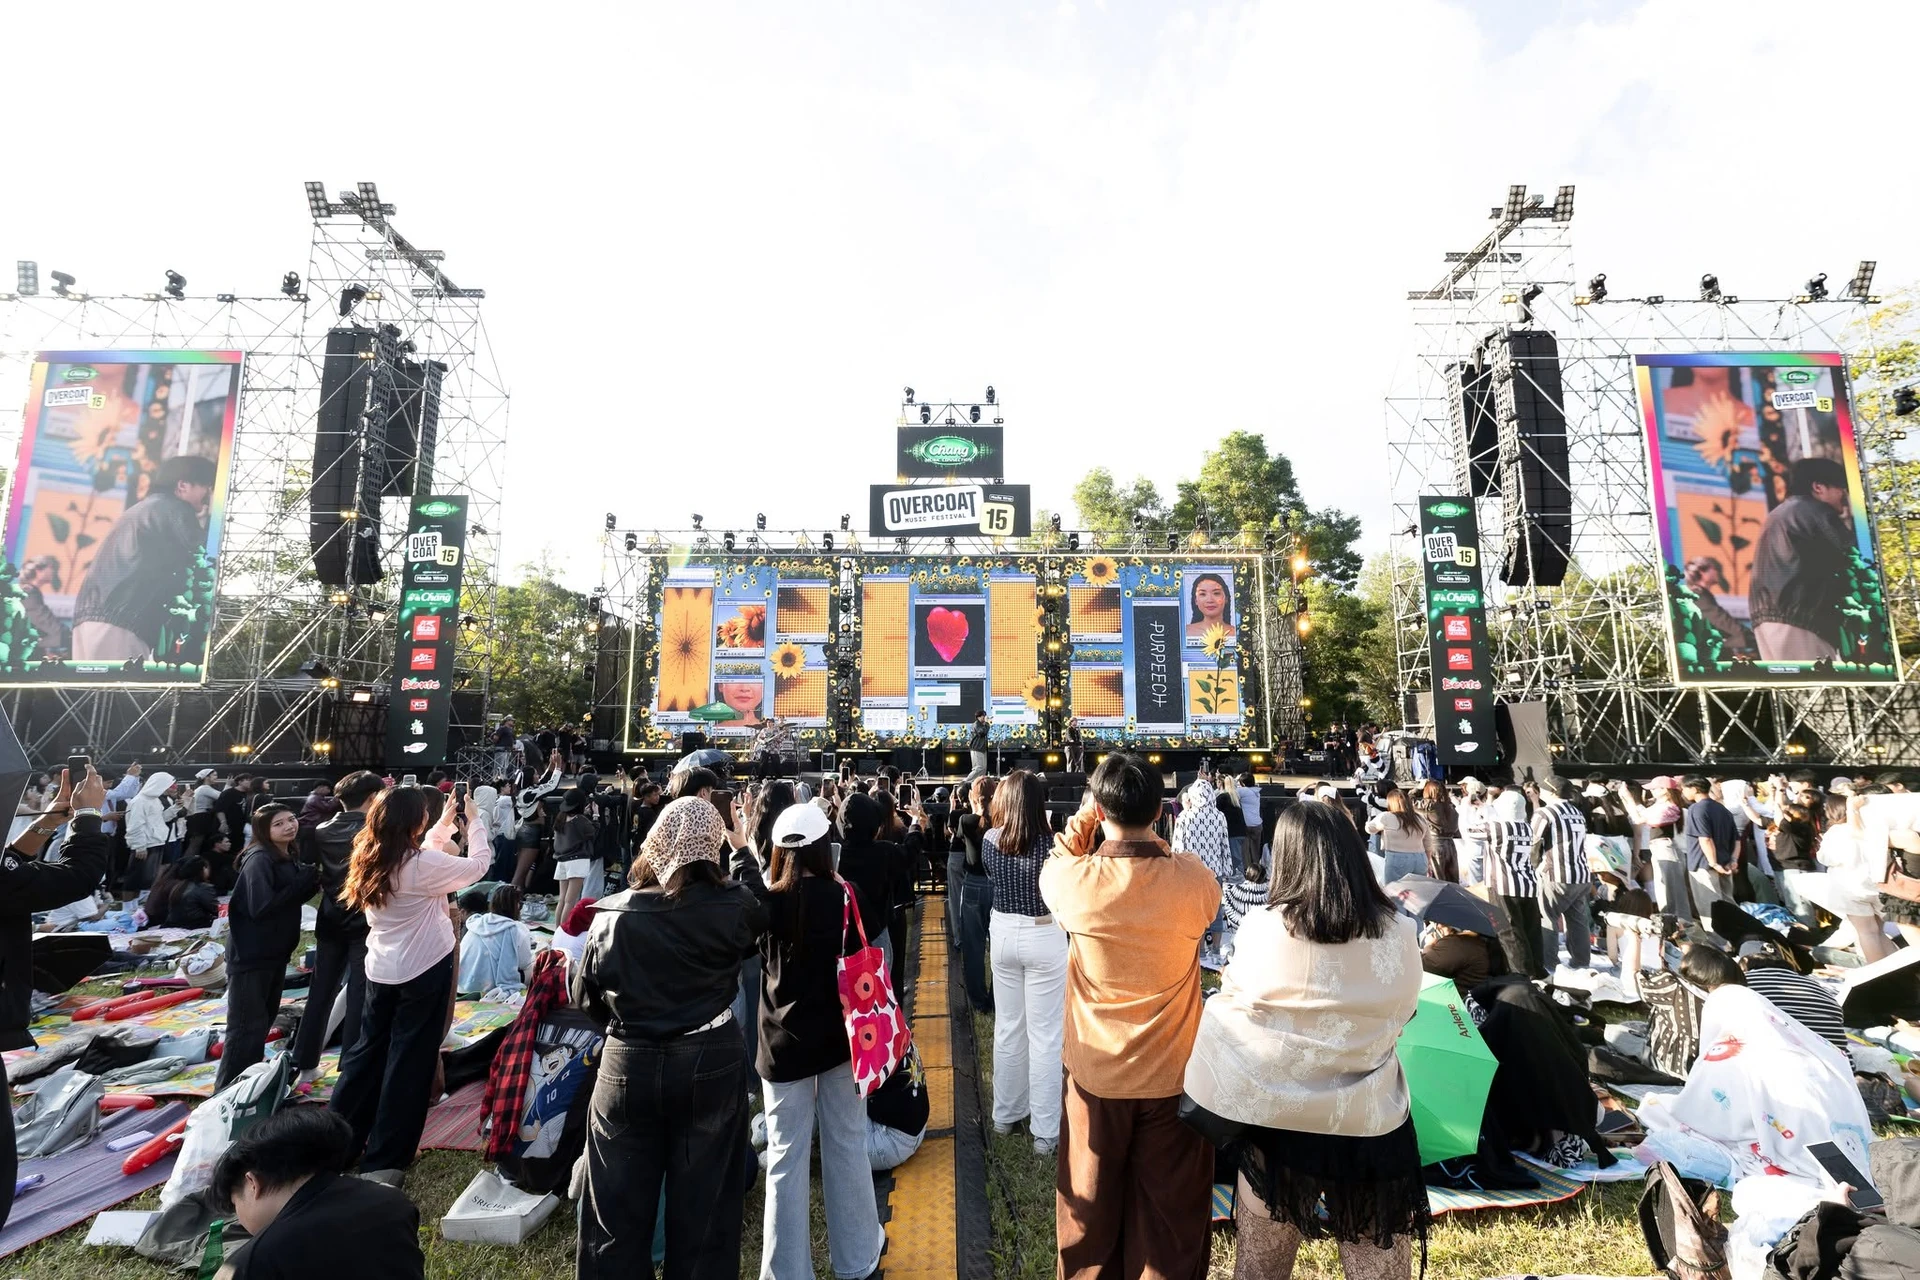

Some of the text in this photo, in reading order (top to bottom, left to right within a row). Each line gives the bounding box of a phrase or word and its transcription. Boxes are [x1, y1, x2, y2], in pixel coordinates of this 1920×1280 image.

[48, 388, 90, 404] OVERCOAT
[92, 396, 103, 407] 15
[1774, 392, 1815, 407] OVERCOAT
[1819, 400, 1830, 410] 15
[928, 443, 970, 458] Chang
[889, 491, 977, 524] OVERCOAT
[931, 513, 967, 521] FESTIVAL
[986, 508, 1008, 531] 15
[412, 536, 438, 550] OVER
[1428, 536, 1454, 550] OVER
[412, 544, 438, 558] COAT
[442, 549, 456, 563] 15
[1430, 544, 1454, 559] COAT
[1459, 550, 1472, 564] 15
[420, 592, 452, 604] Chang
[1446, 592, 1476, 604] Chang
[1150, 620, 1168, 708] PURPEECH
[401, 678, 440, 690] Bento
[1442, 678, 1482, 690] Bento
[1448, 1003, 1472, 1039] Anlene
[546, 1088, 558, 1104] 10
